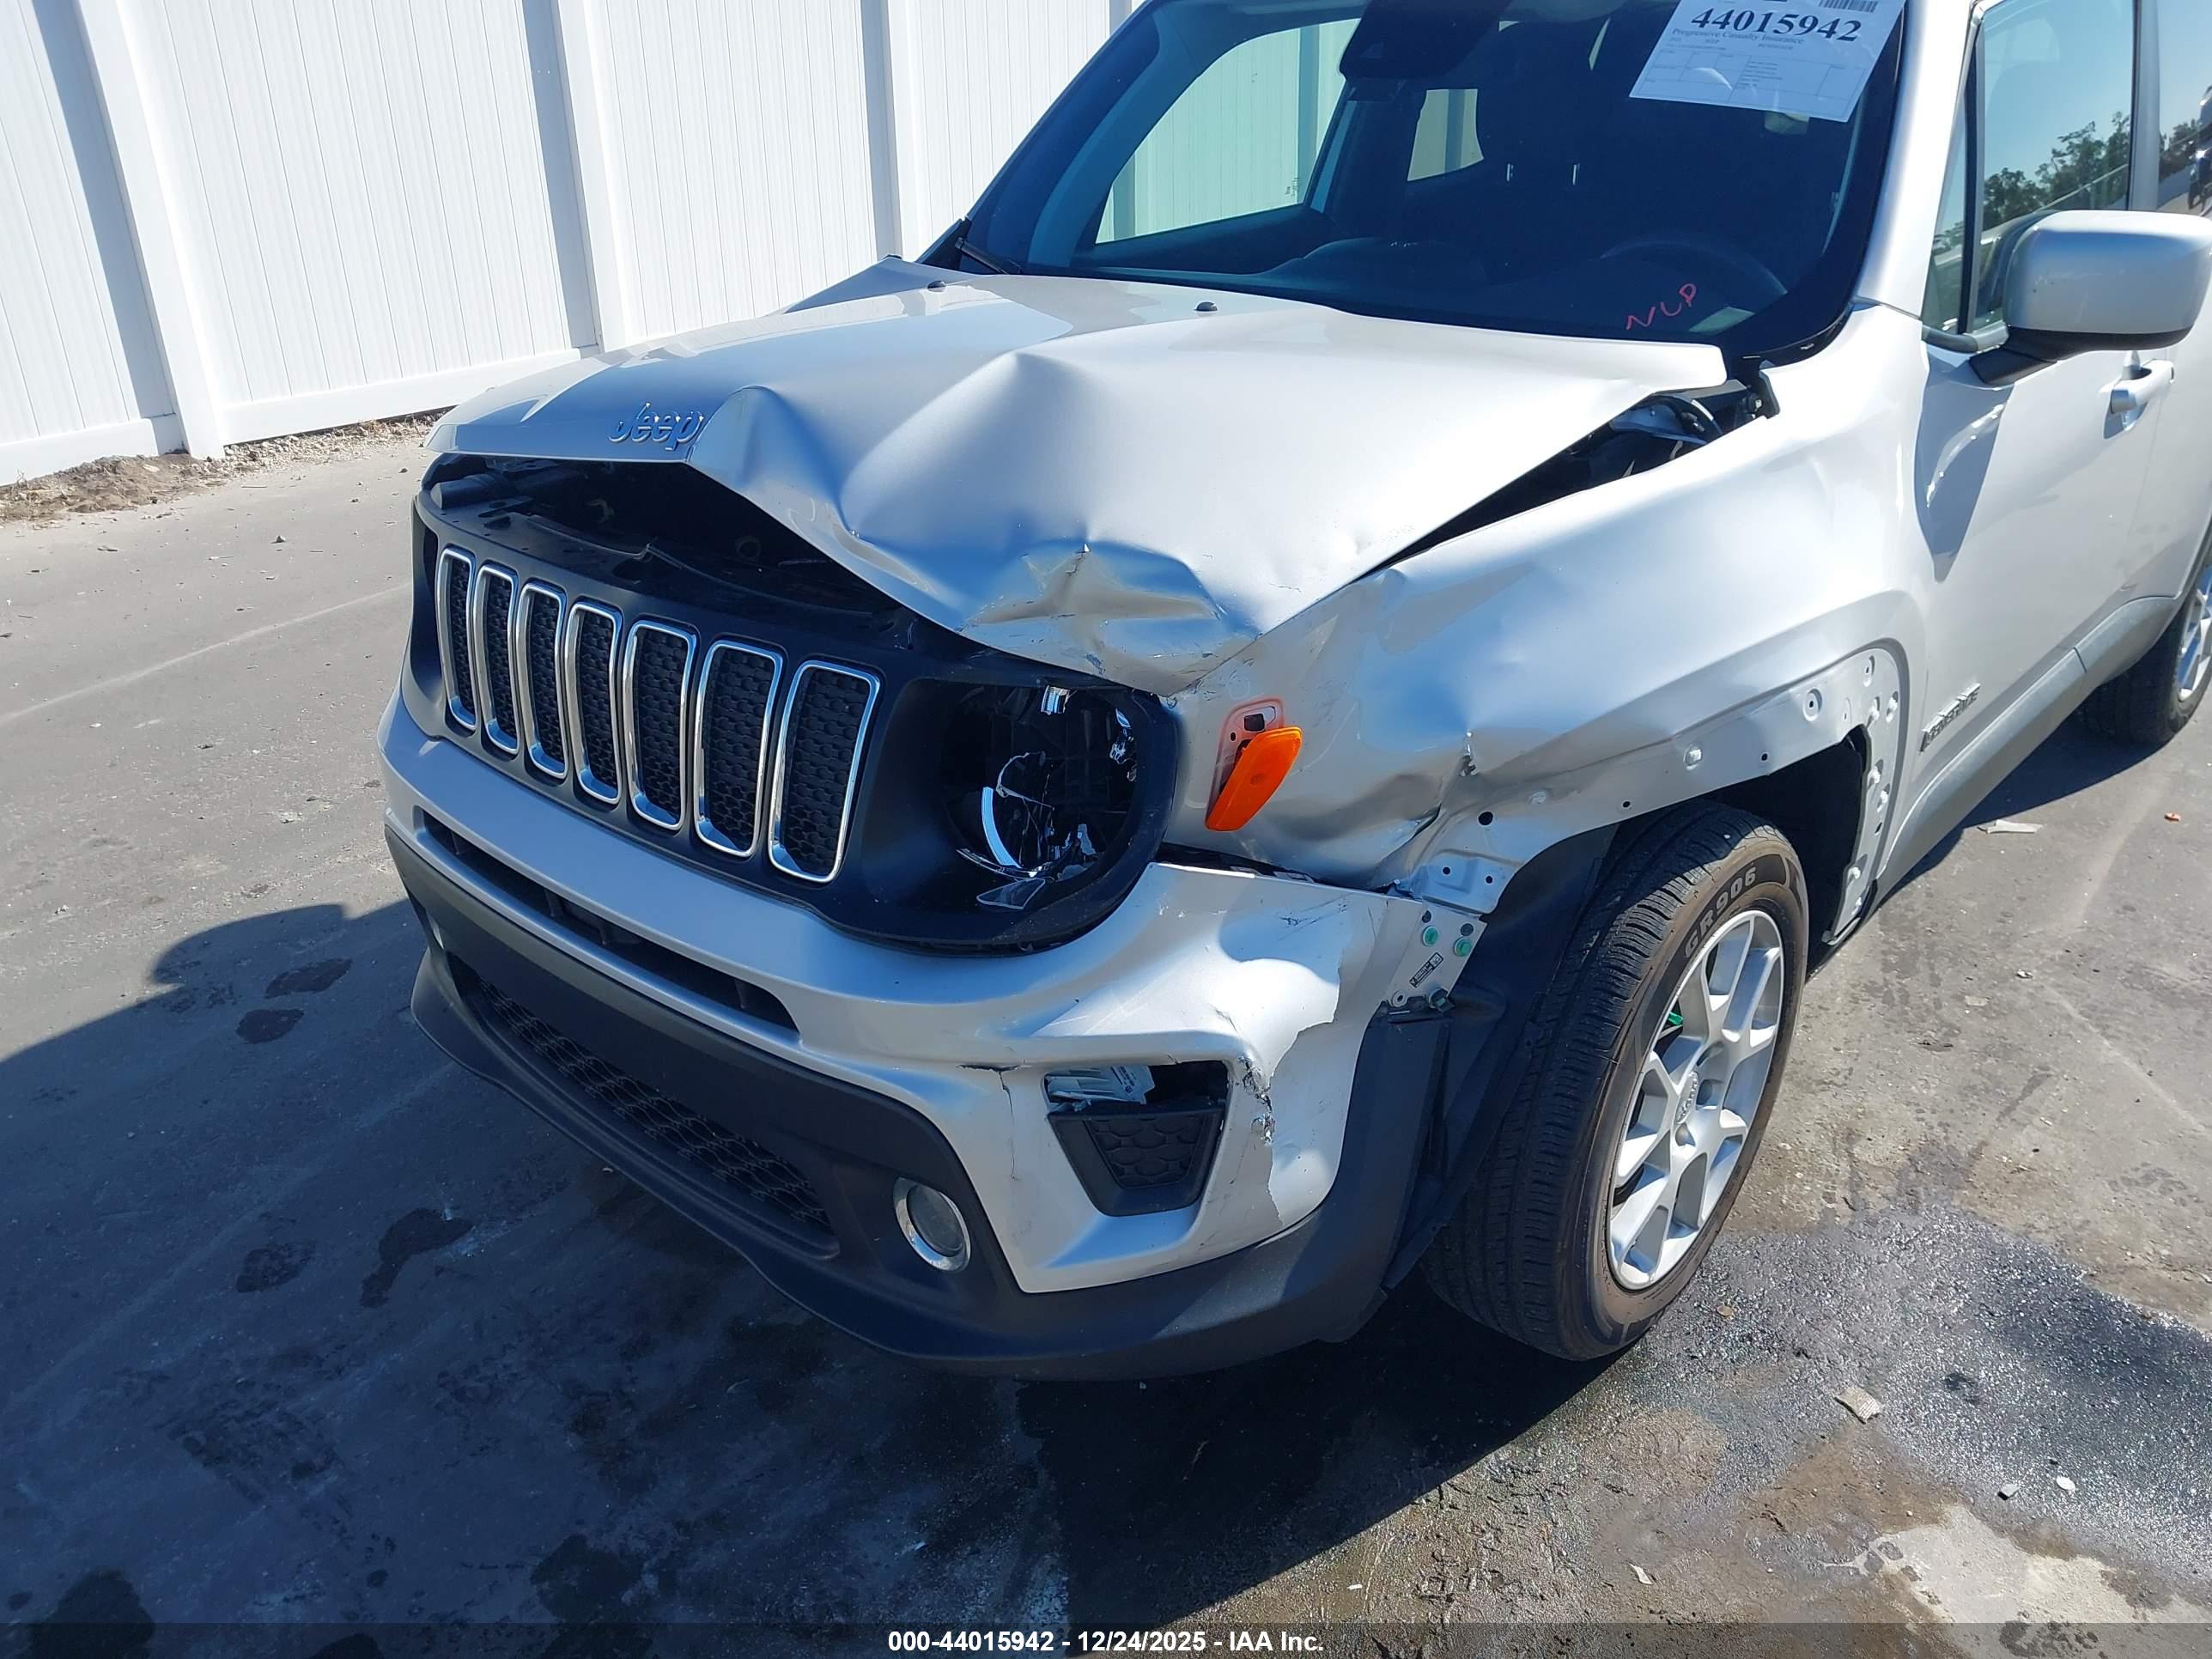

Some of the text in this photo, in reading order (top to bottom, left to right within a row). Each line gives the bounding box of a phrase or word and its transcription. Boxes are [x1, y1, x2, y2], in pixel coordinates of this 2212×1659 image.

[1690, 8, 1862, 42] 44015942
[1723, 32, 1759, 41] Casualty
[1761, 34, 1805, 44] Insurance
[607, 402, 705, 452] Jeep
[1684, 866, 1757, 959] GR906
